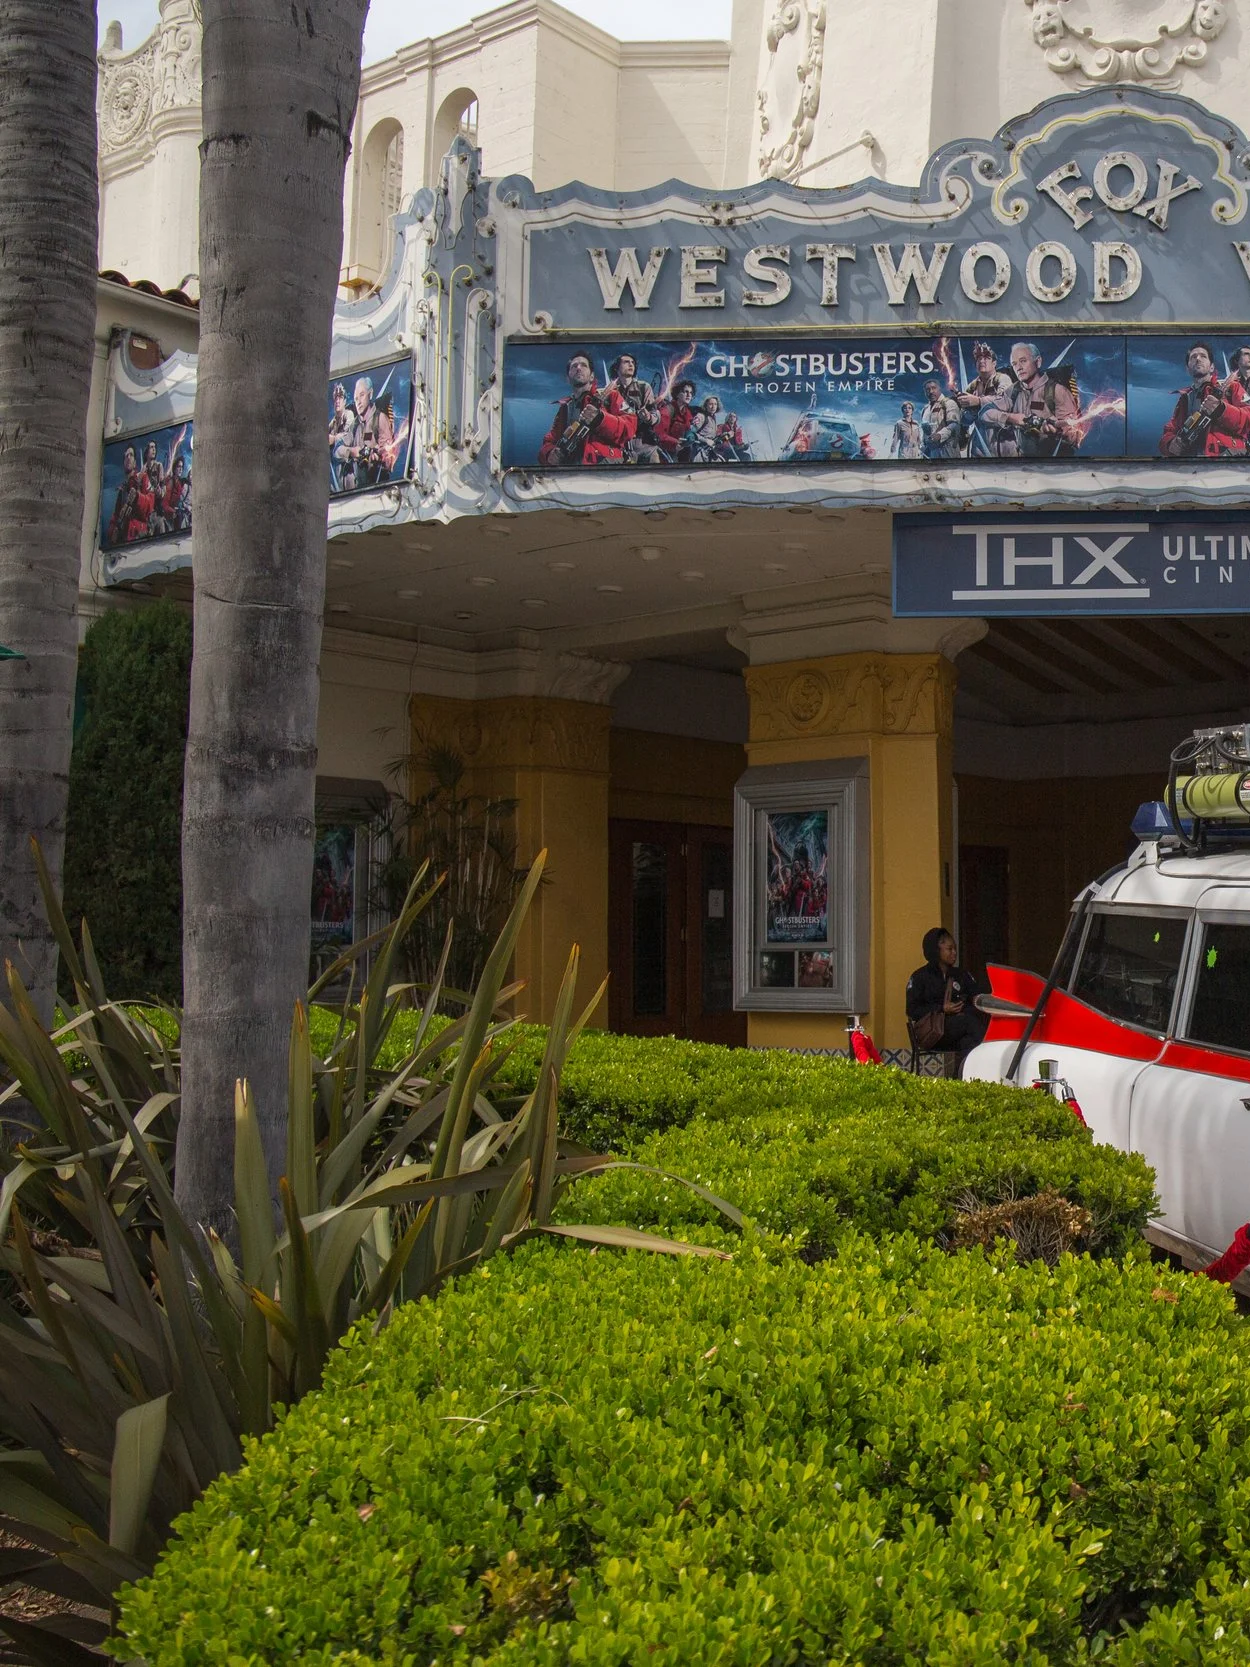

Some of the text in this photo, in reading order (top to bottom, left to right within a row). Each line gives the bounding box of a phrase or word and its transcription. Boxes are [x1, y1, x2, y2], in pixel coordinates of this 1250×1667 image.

[1036, 151, 1203, 231] FOX
[587, 240, 1143, 310] WESTWOOD
[745, 378, 895, 394] FROZEN EMPIRE
